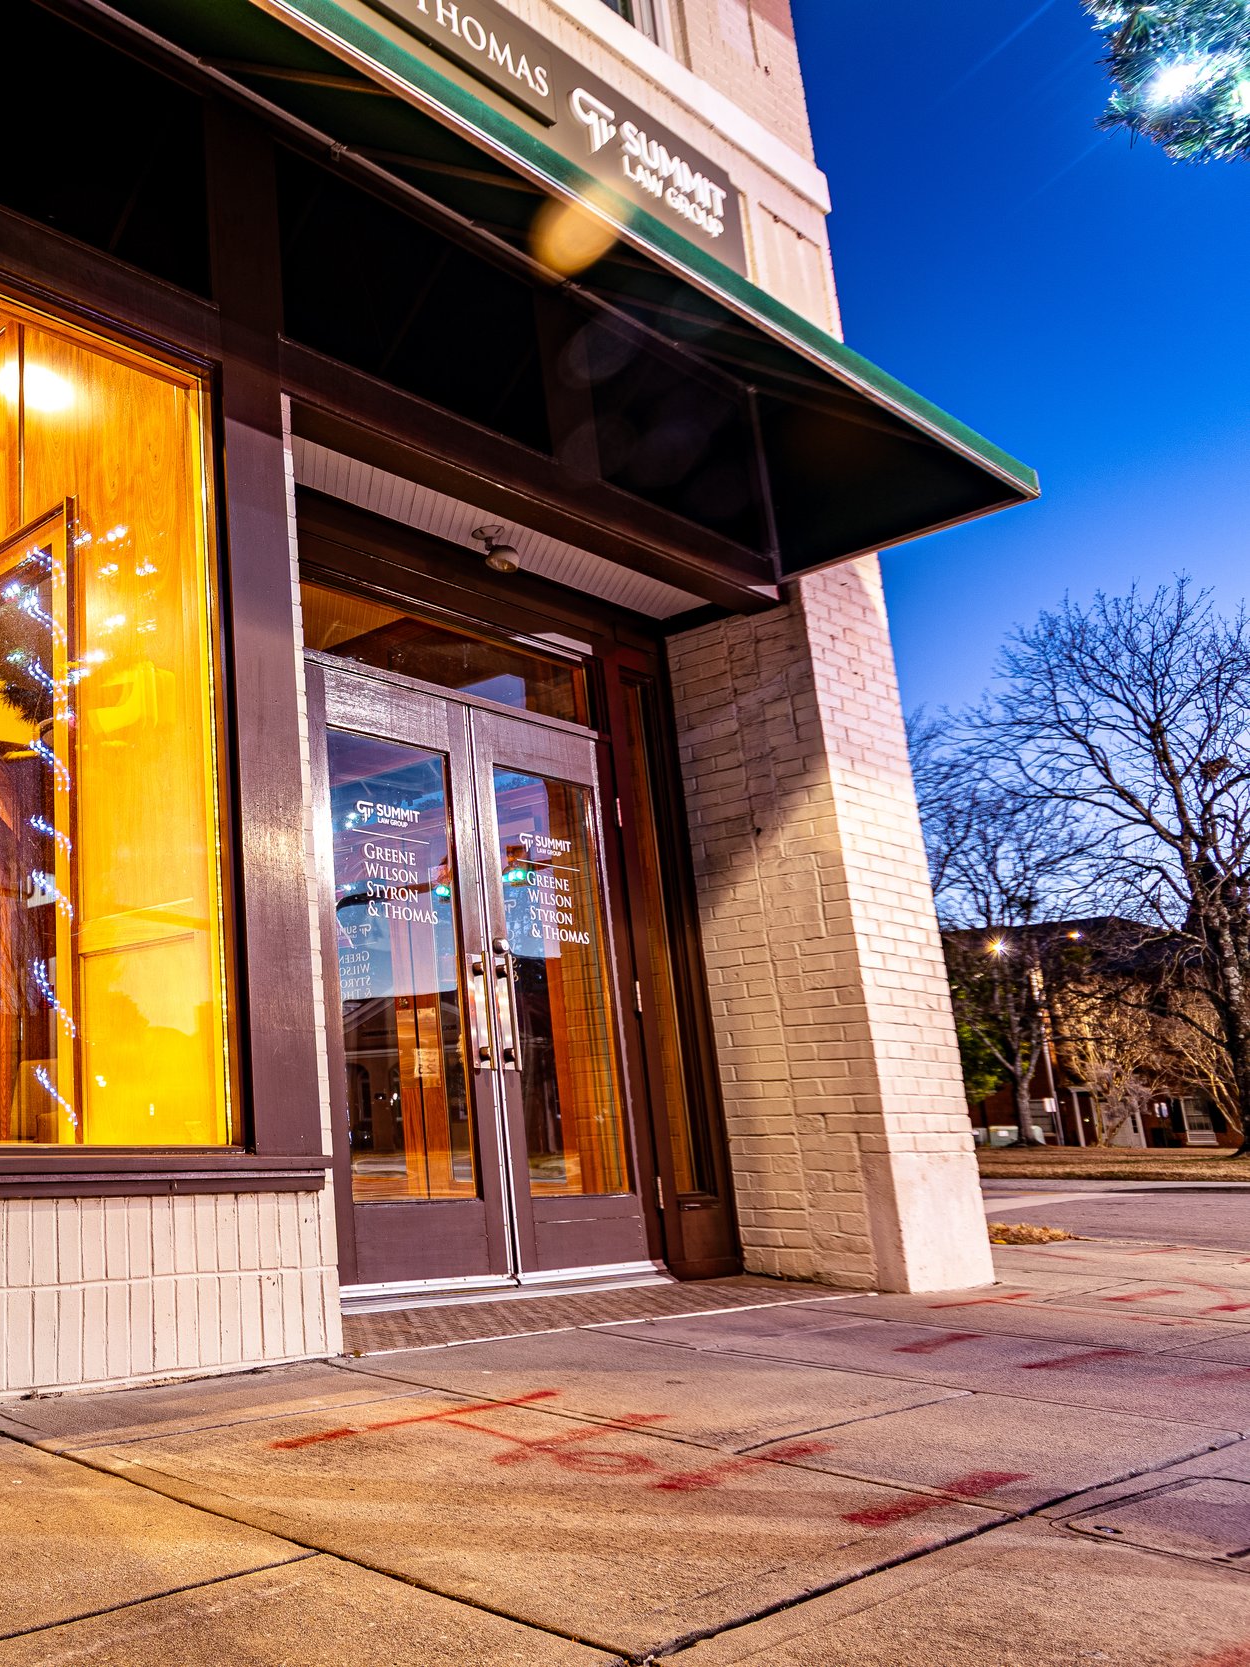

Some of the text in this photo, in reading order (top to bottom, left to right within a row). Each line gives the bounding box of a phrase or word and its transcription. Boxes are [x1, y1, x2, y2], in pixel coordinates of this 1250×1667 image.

[619, 120, 726, 218] SUMMIT
[622, 154, 724, 238] LAW GROUP
[376, 803, 421, 824] SUMMIT
[377, 817, 409, 828] LAW GROUP
[363, 842, 416, 866] GREENE
[535, 837, 571, 853] SUMMIT
[546, 849, 562, 857] GROUP
[364, 861, 418, 885] WILSON
[526, 871, 570, 892] GREENE
[366, 880, 419, 904] STYRON
[527, 888, 572, 909] WILSON
[367, 901, 439, 925] & THOMAS
[530, 906, 573, 926] STYRON
[531, 923, 590, 945] & THOMAS
